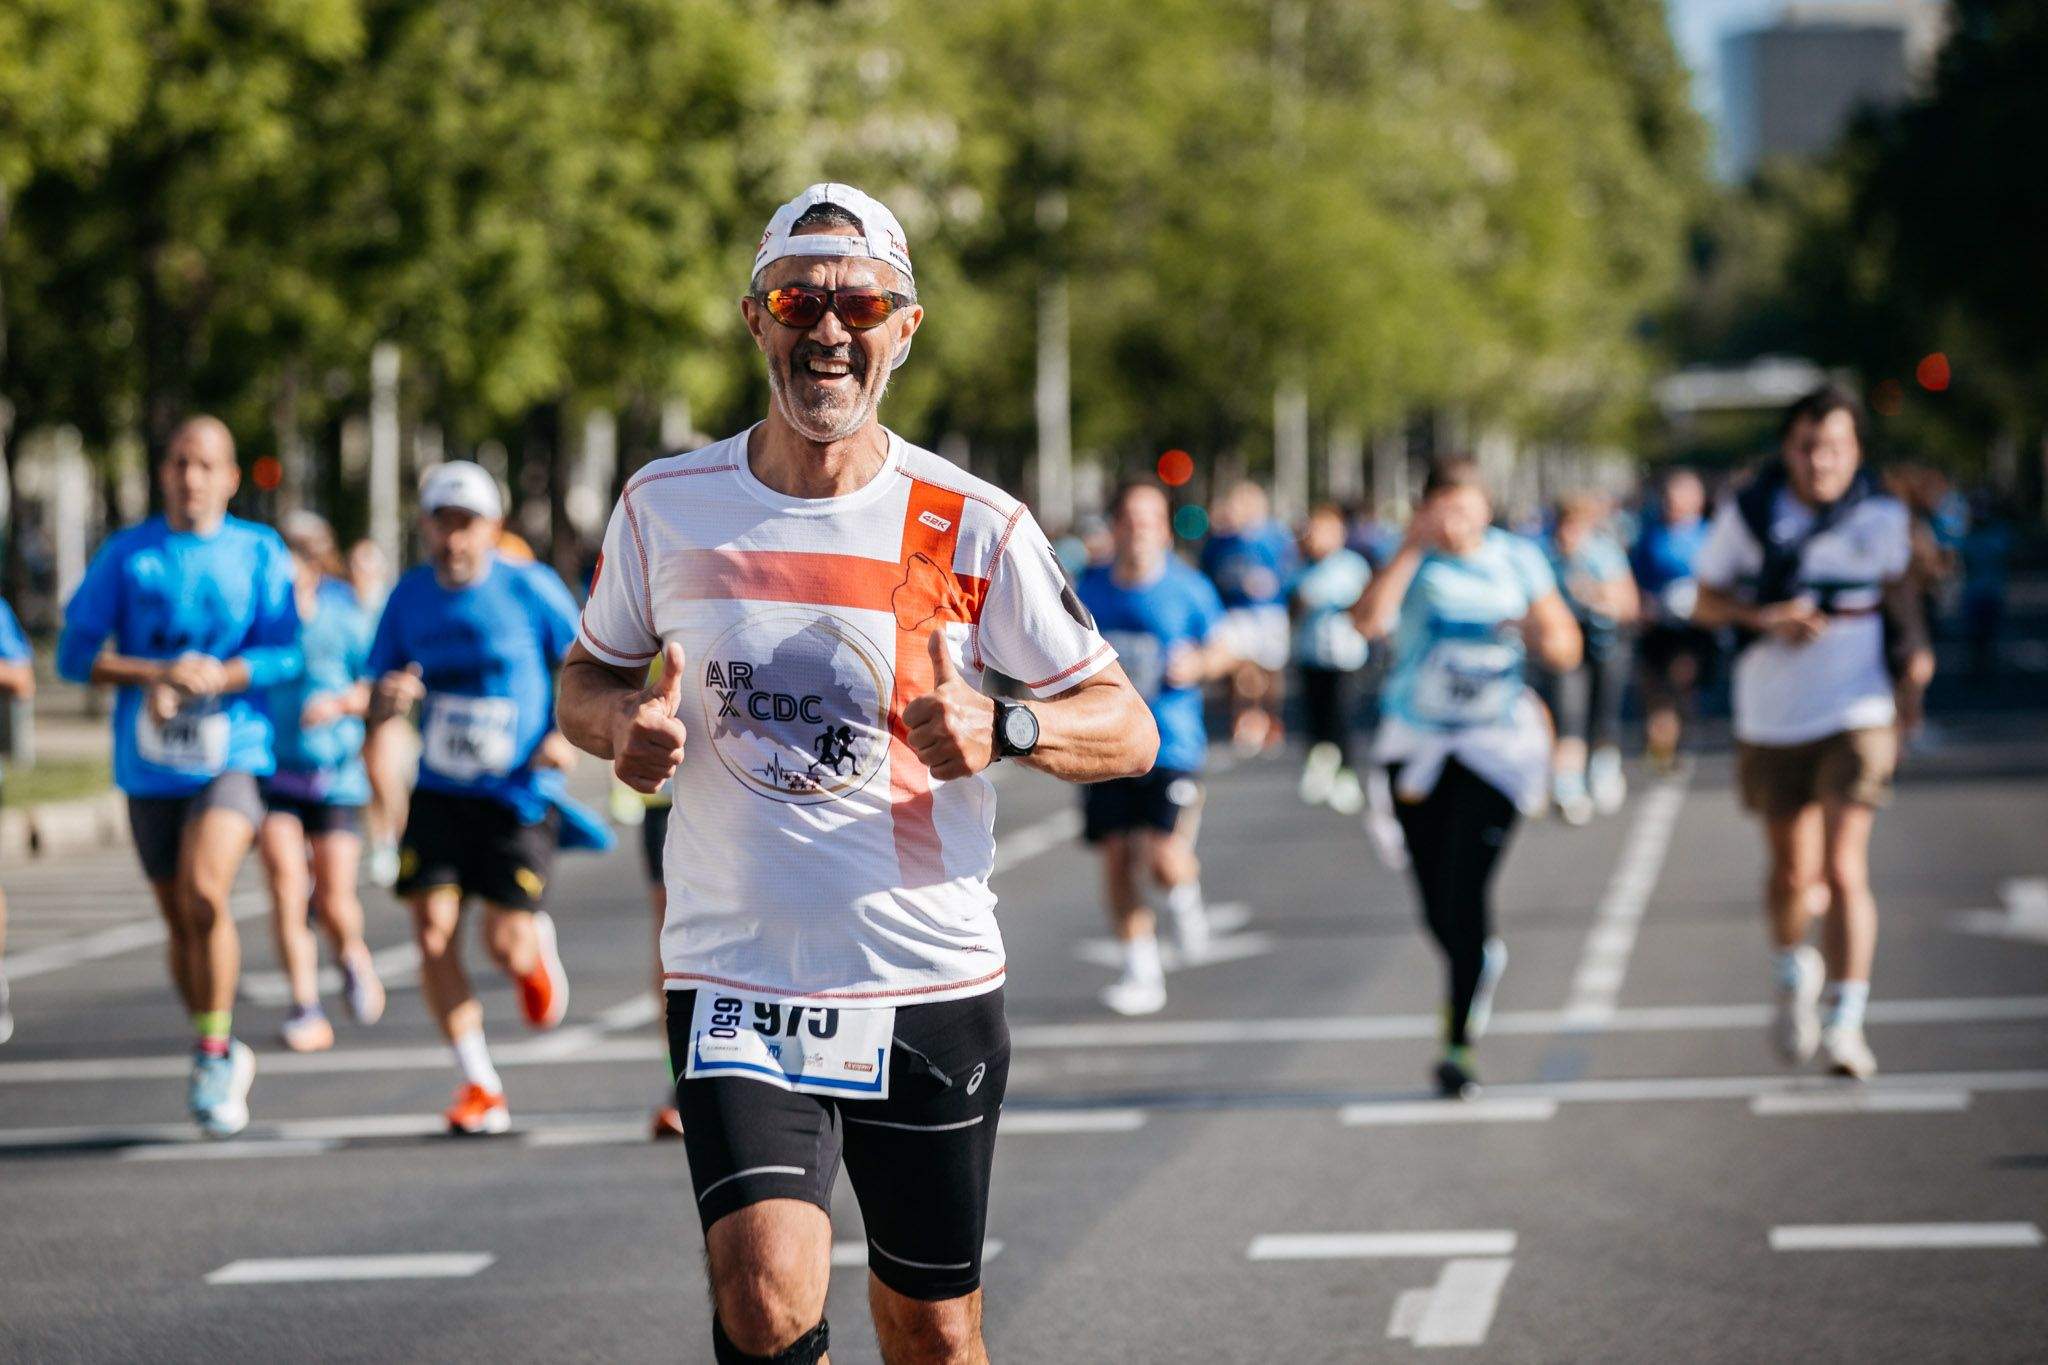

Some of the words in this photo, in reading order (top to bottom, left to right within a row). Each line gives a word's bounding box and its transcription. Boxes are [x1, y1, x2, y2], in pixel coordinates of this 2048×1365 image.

[706, 660, 753, 690] AR
[748, 691, 824, 724] CDC
[709, 997, 742, 1039] 650
